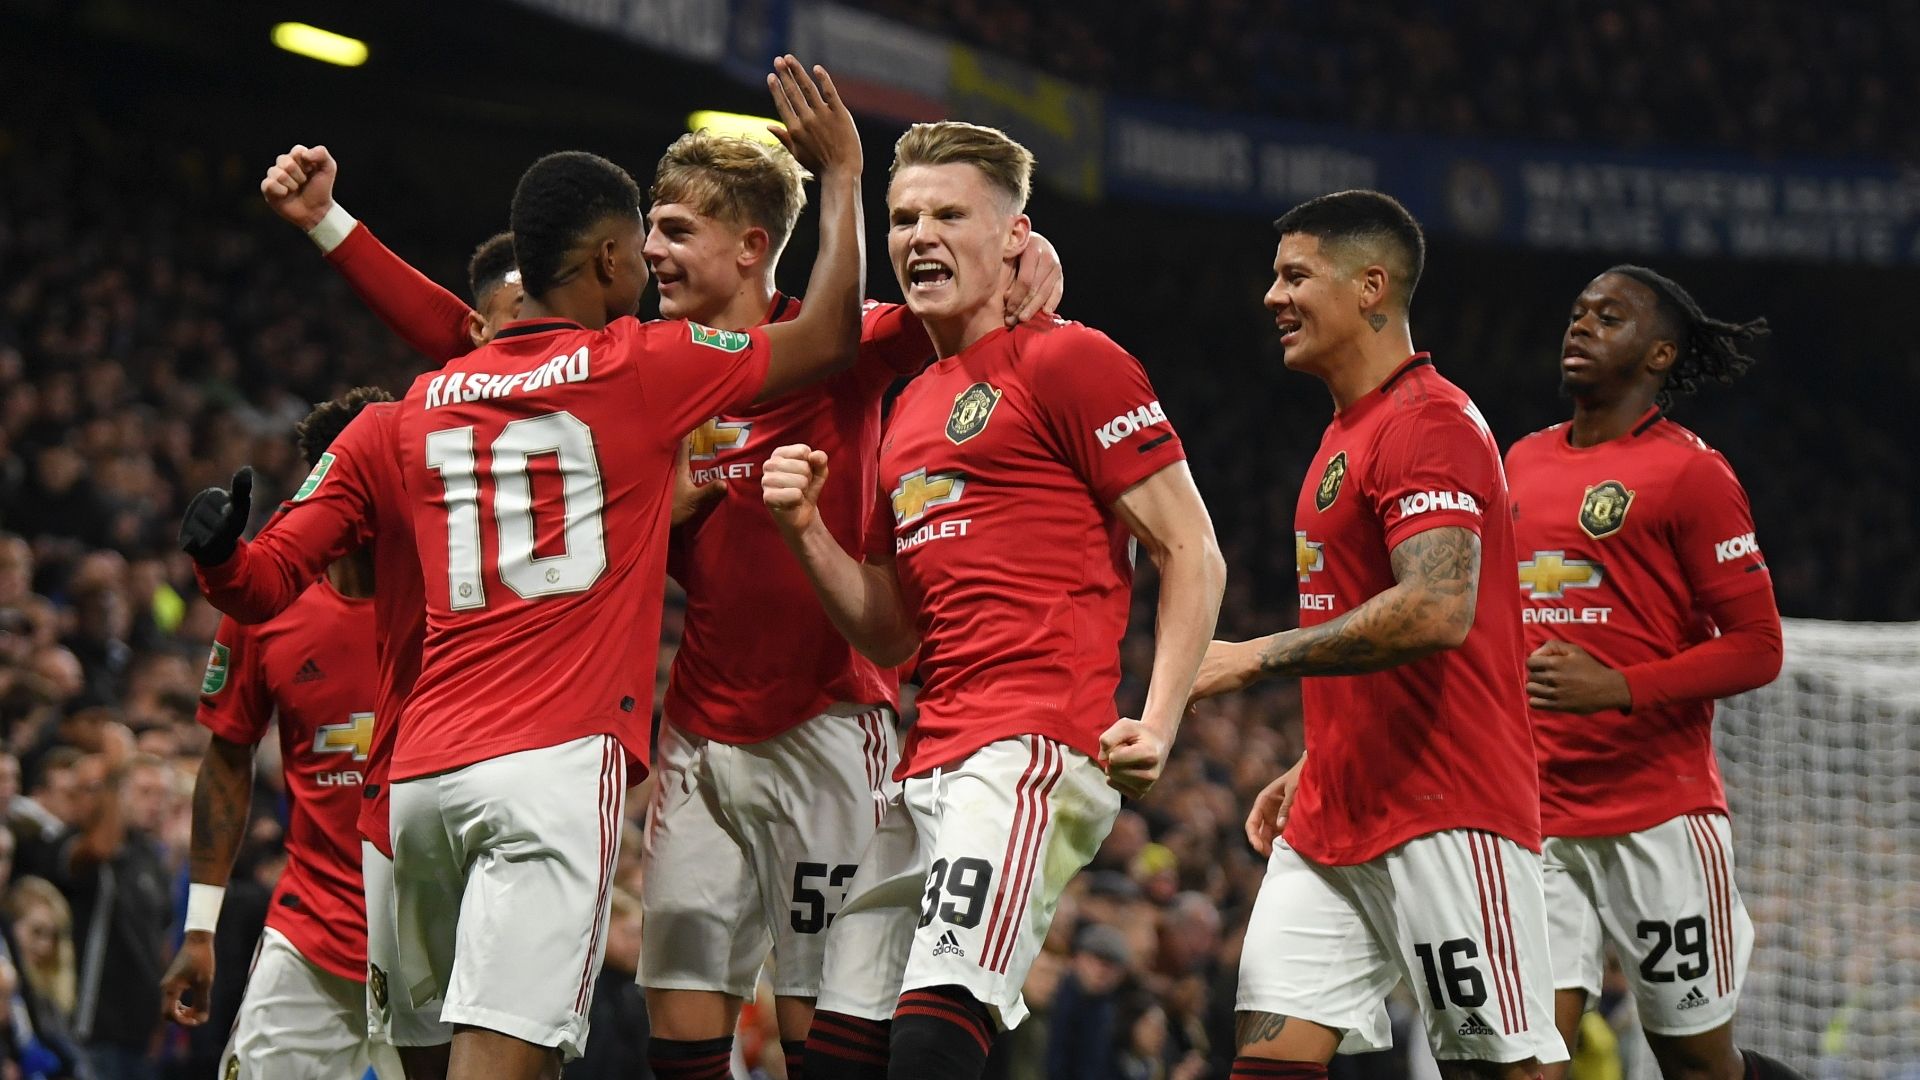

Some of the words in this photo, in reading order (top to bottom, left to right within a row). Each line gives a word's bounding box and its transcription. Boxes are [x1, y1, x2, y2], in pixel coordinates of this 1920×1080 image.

[424, 346, 591, 410] RASHFORD
[425, 410, 607, 612] 10
[1522, 607, 1613, 624] EVROLET
[932, 943, 965, 957] adidas
[1414, 937, 1488, 1011] 16
[1636, 914, 1710, 983] 29
[1458, 1026, 1494, 1036] adidas
